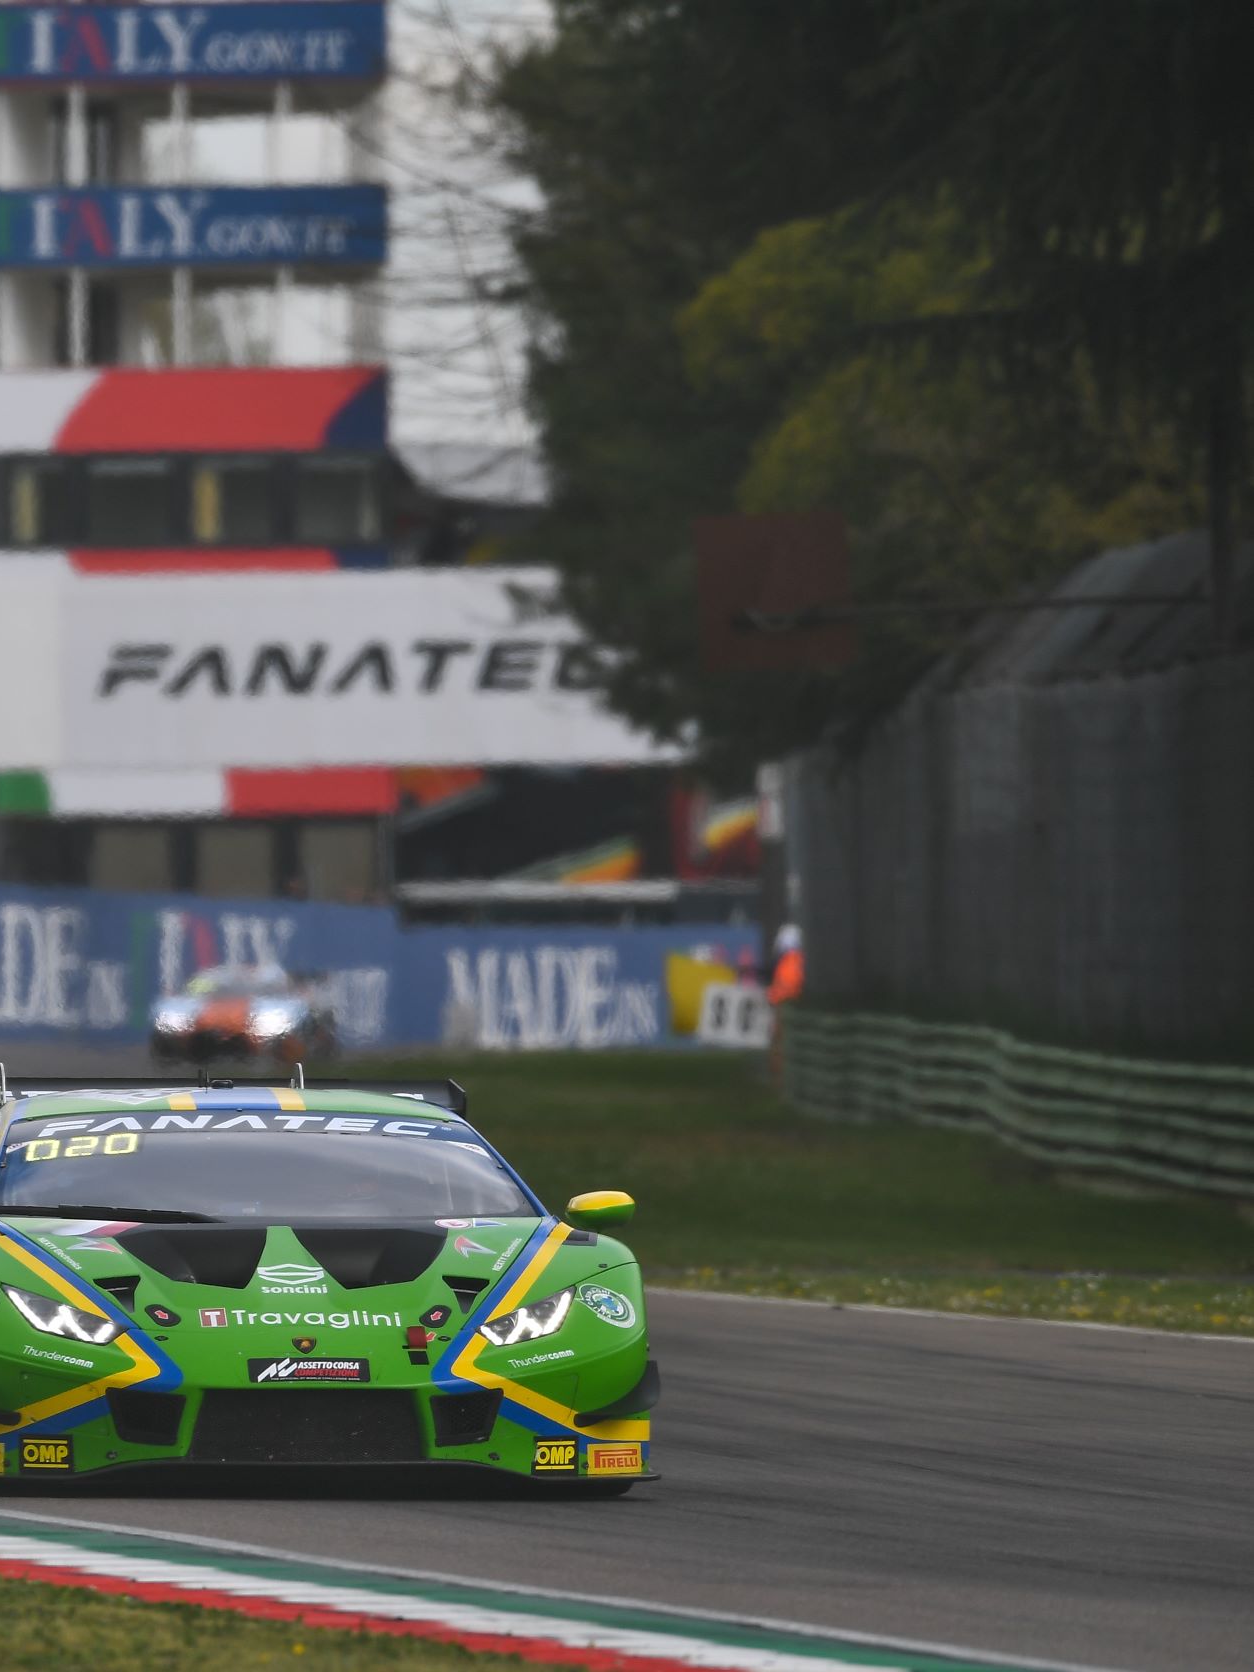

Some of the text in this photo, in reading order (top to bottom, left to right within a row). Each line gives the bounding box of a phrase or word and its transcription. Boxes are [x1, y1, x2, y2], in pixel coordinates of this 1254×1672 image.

[37, 1114, 436, 1138] FANATEC
[25, 1132, 140, 1163] 020
[261, 1284, 328, 1294] soncini
[231, 1309, 402, 1329] Travaglini
[23, 1345, 94, 1369] Thundercomm
[508, 1349, 575, 1370] Thundercomm
[23, 1444, 69, 1463] OMP
[536, 1446, 575, 1464] OMP
[594, 1448, 638, 1469] PIRELLI
